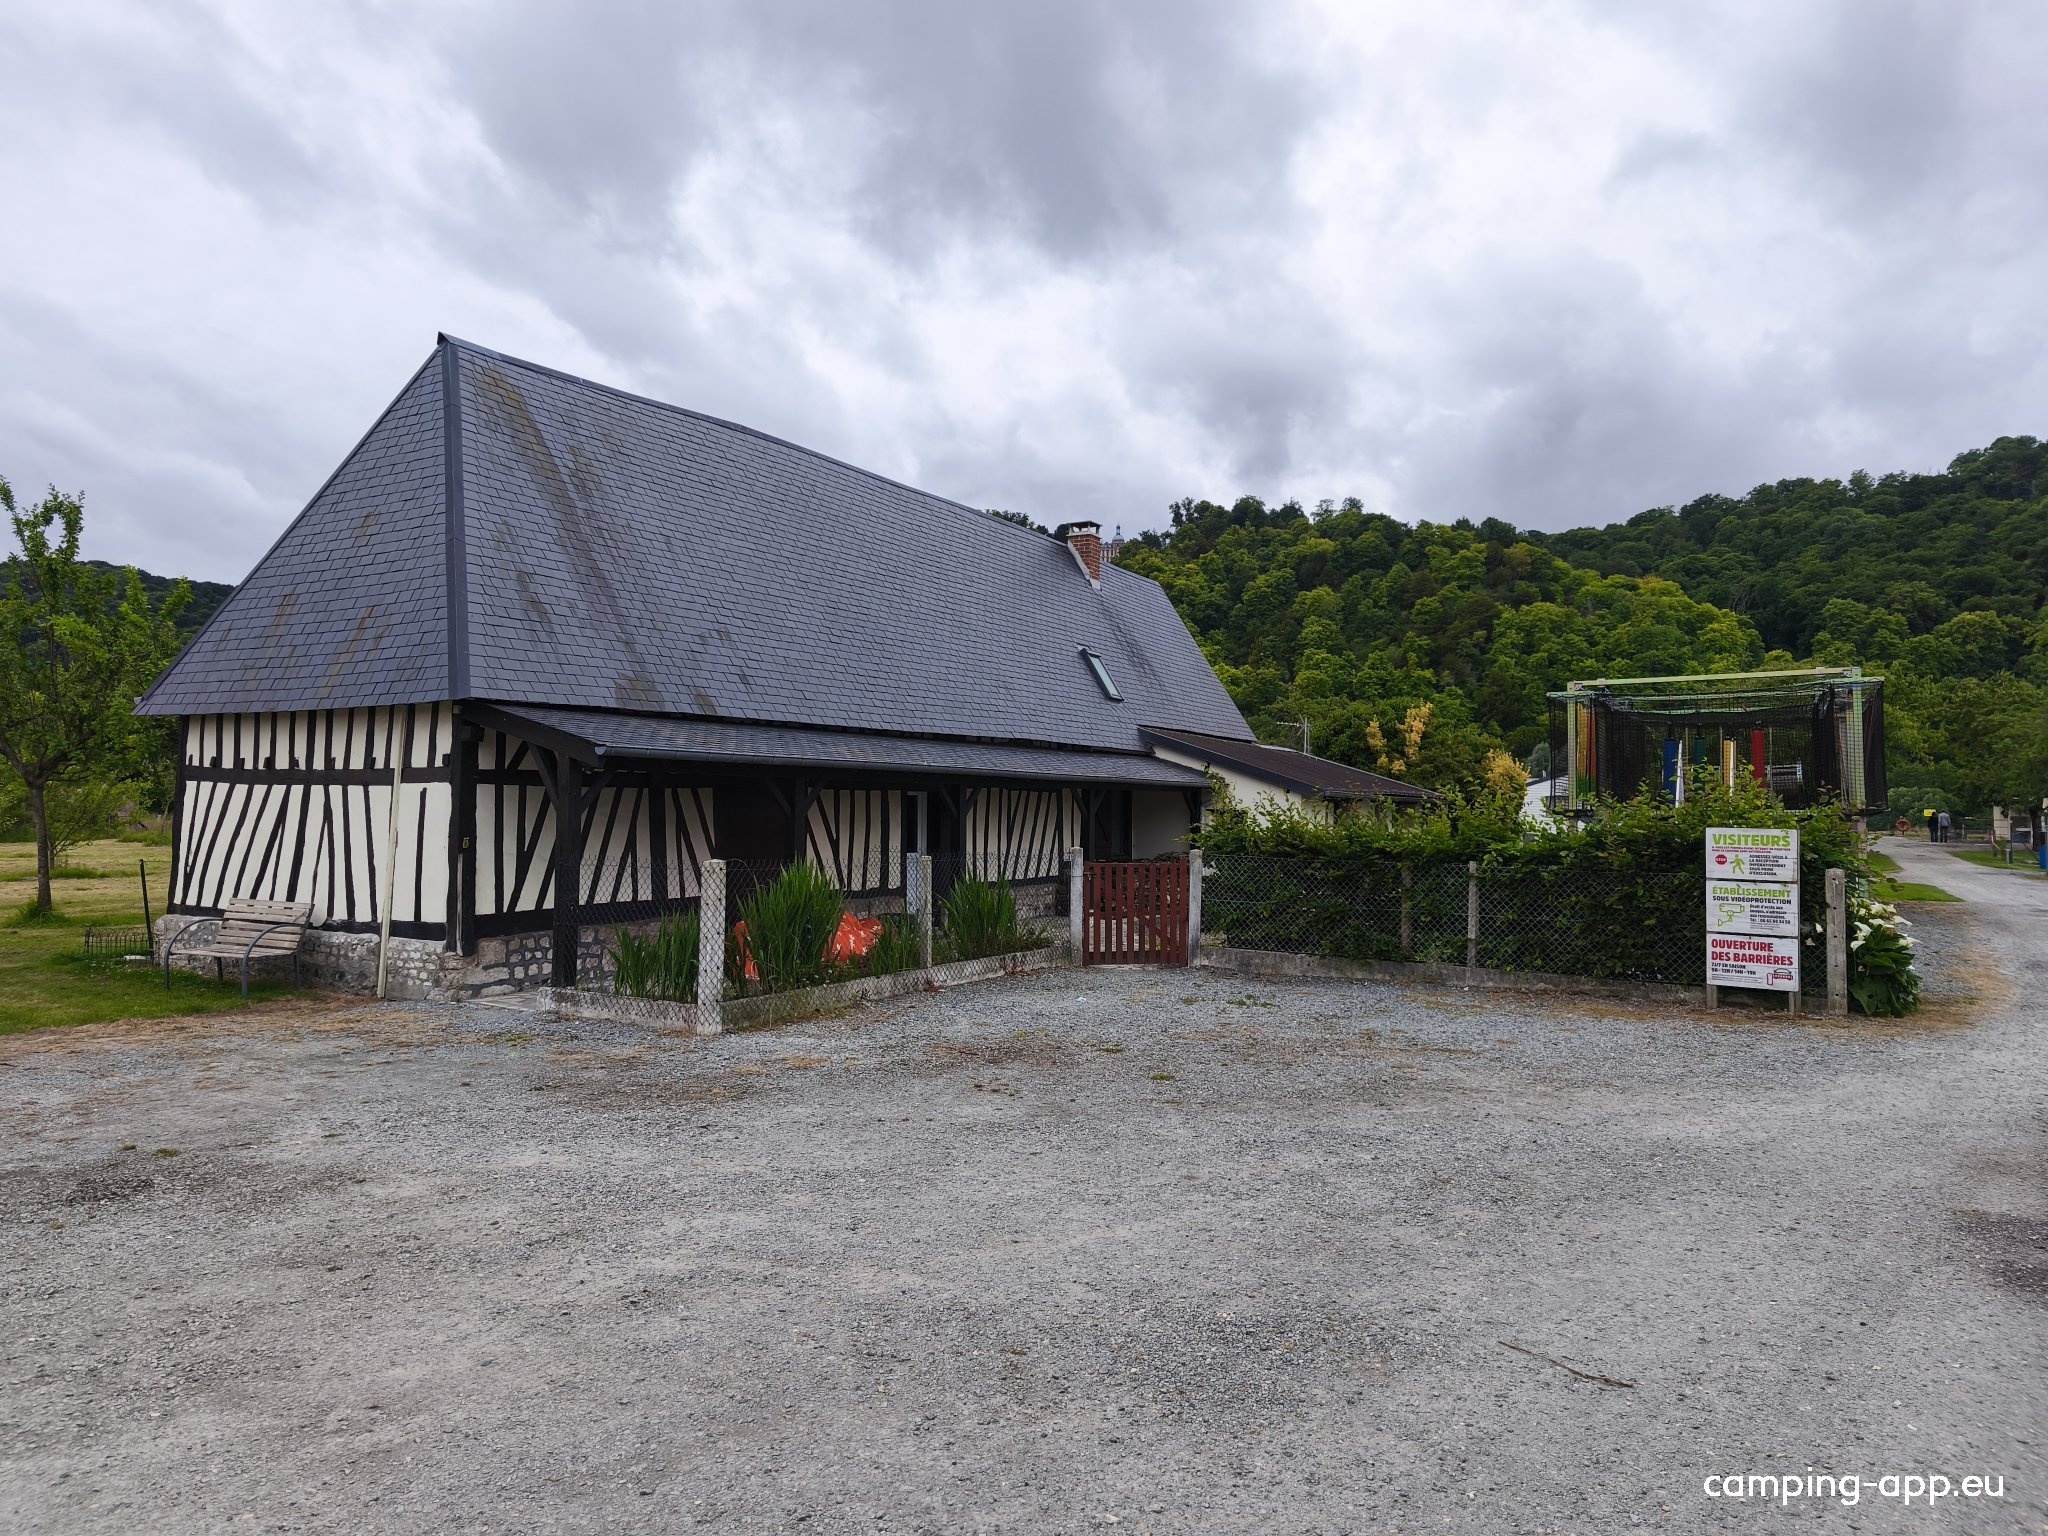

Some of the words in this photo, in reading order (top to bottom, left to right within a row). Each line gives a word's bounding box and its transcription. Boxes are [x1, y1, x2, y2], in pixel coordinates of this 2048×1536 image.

[1712, 833, 1790, 847] VISITEURS
[1712, 885, 1791, 898] ÉTABLISSEMENT
[1730, 896, 1792, 905] VIDÉOPROTECTION
[1711, 938, 1774, 952] OUVERTURE
[1711, 951, 1731, 962] DES
[1732, 953, 1793, 966] BARRIÈRES
